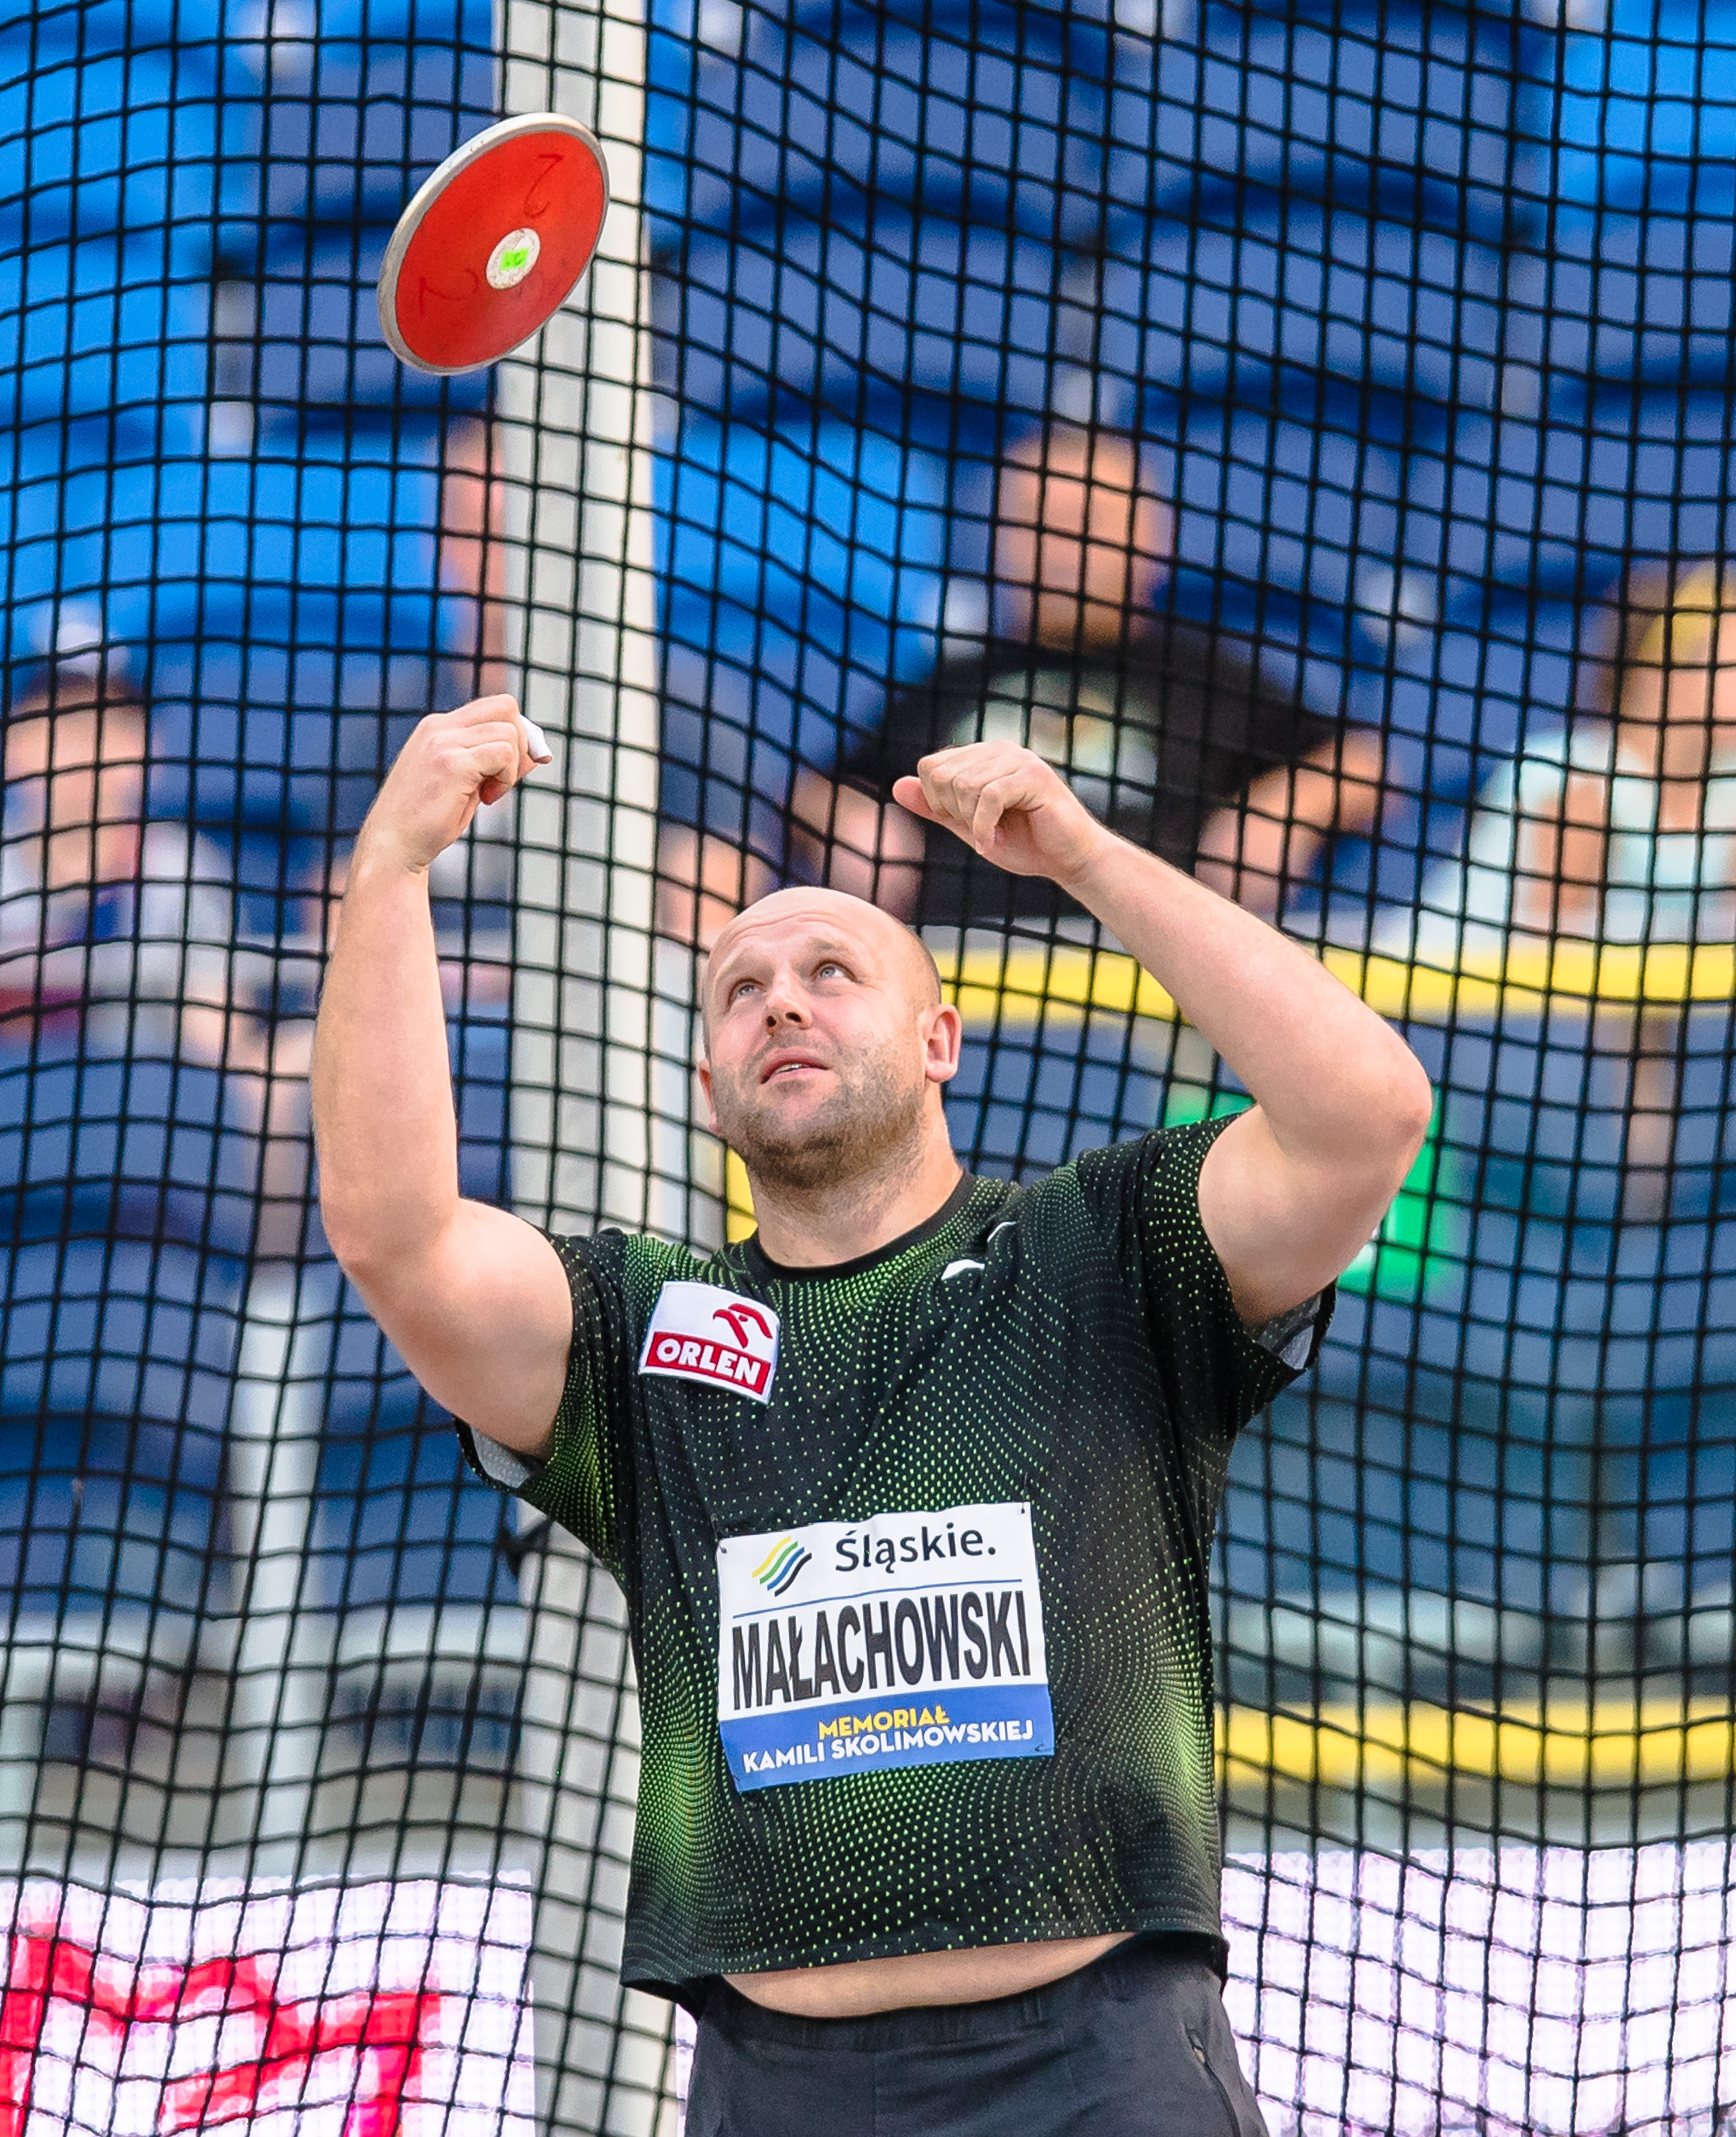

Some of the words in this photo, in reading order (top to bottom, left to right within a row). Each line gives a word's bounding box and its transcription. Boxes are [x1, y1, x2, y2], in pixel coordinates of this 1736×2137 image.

[656, 1338, 762, 1386] ORLEN
[835, 1522, 997, 1574] Śląskie.
[732, 1590, 1032, 1711] MAŁACHOWSKI
[742, 1741, 826, 1773] KAMILI
[831, 1719, 1034, 1761] SKOLIMOWSKIEJ
[818, 1705, 950, 1741] MEMORIAŁ
